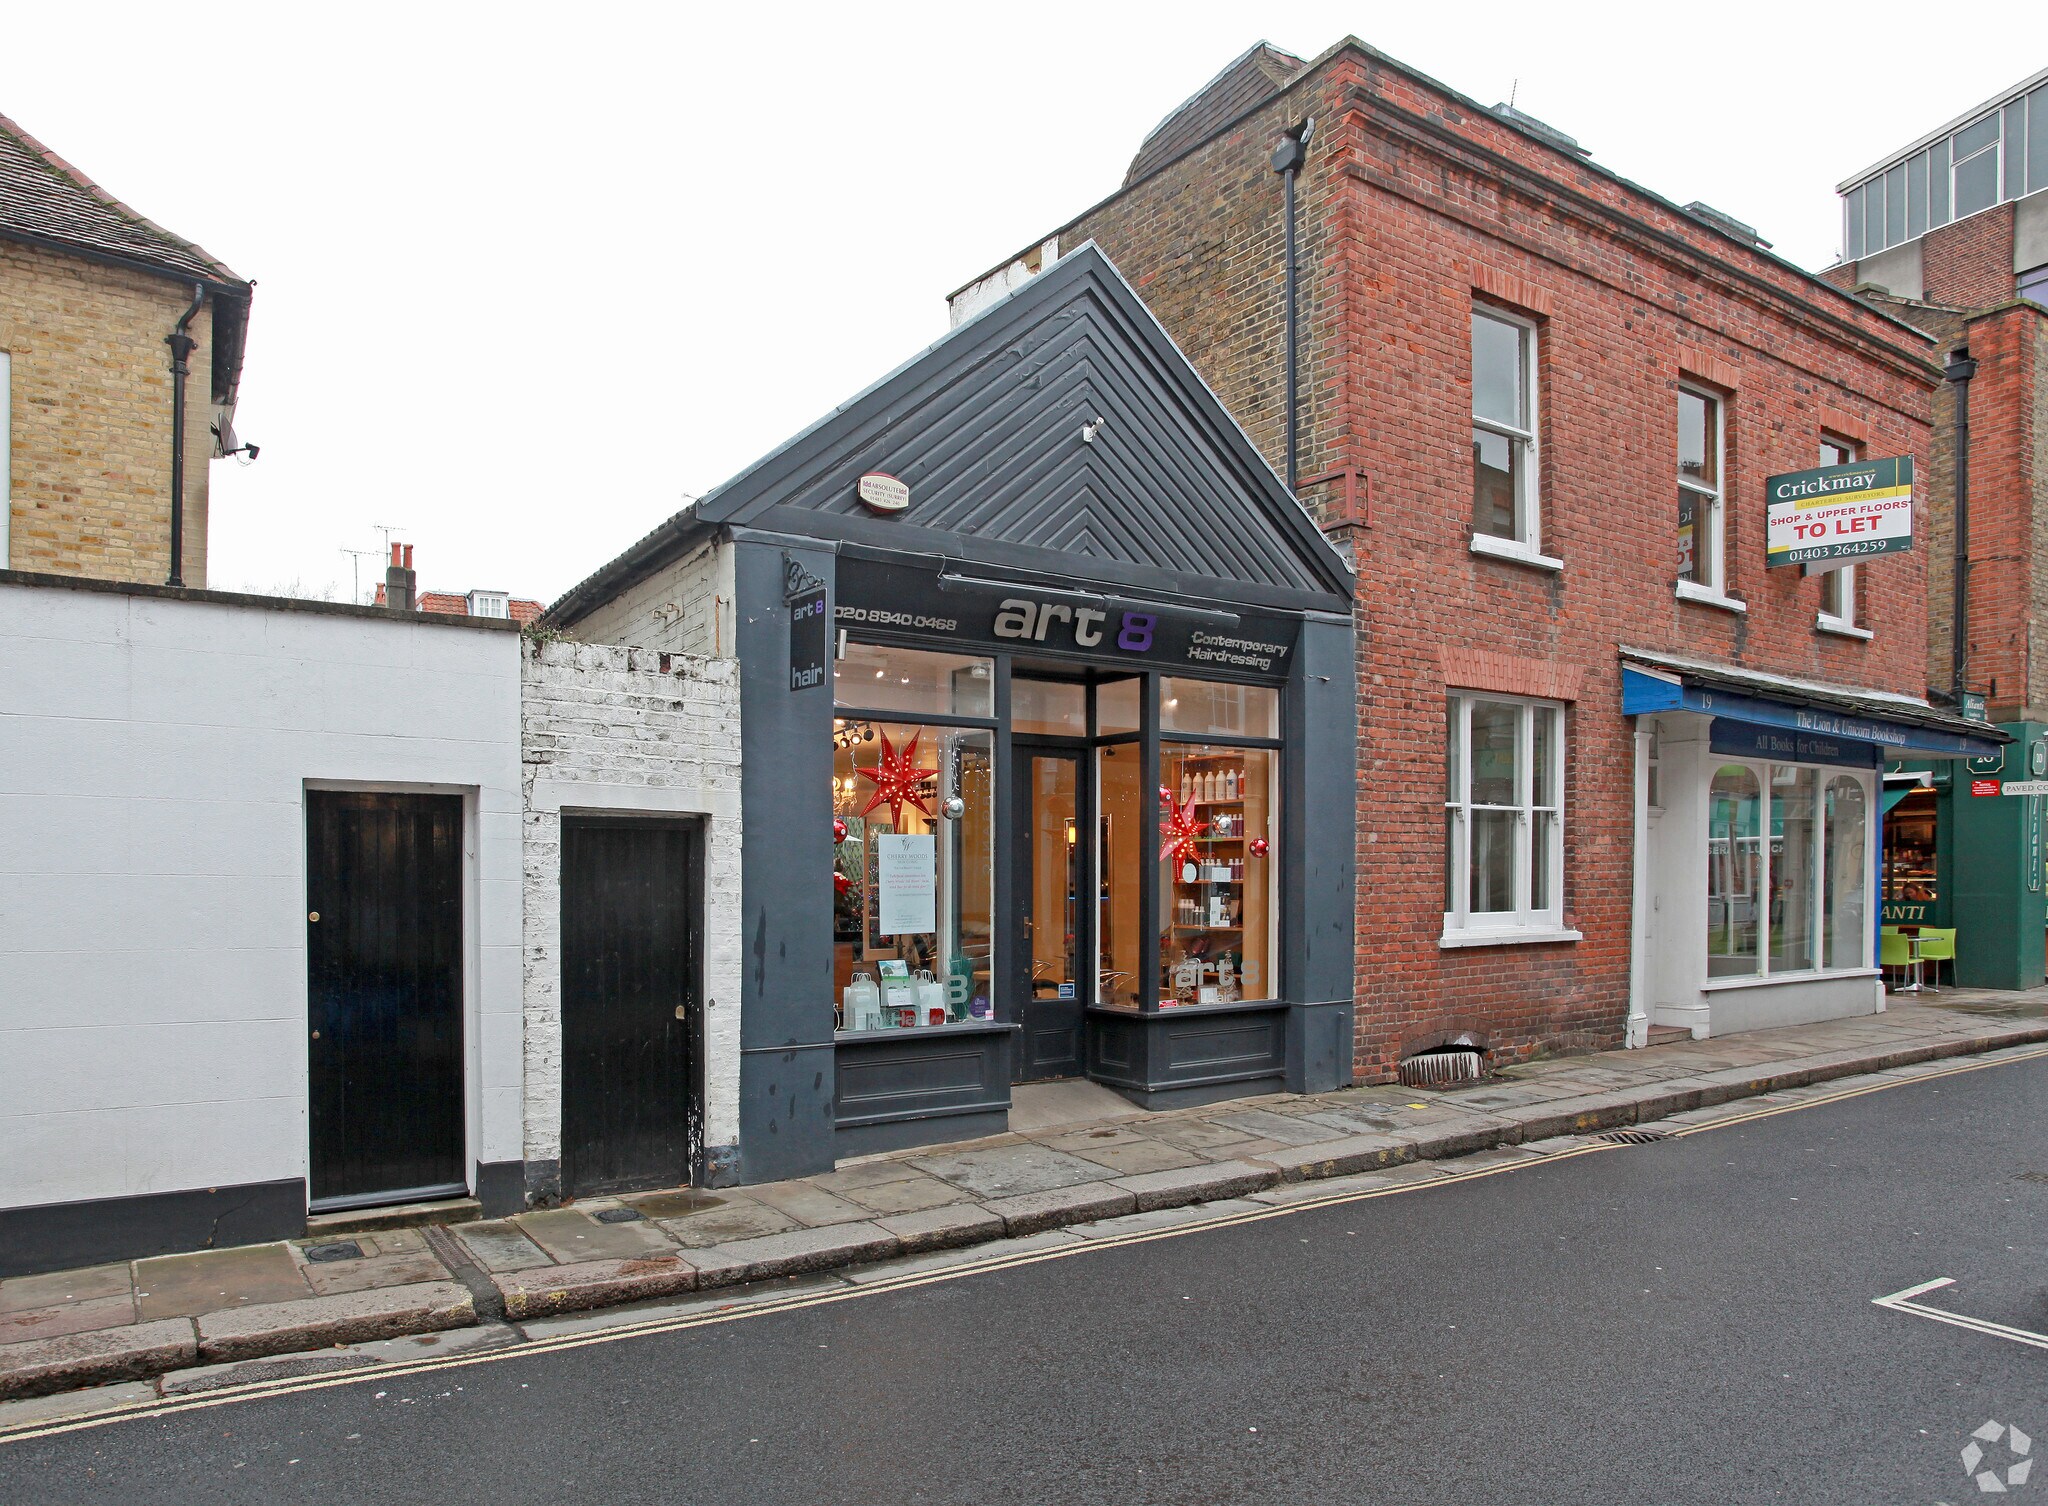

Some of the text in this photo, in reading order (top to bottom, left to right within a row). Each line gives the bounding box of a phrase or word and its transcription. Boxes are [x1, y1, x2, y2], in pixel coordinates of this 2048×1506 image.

[872, 483, 900, 493] ABSOLUTE
[1776, 474, 1876, 498] Crickmay
[1801, 491, 1885, 507] CHARTERED SURVEYORS
[1770, 500, 1908, 526] SHOP & UPPER FLOORS
[1793, 515, 1882, 540] TO LET
[1789, 540, 1887, 561] 01403 264259
[794, 600, 824, 621] art 8
[834, 606, 958, 631] 020 8940 0468
[993, 598, 1157, 652] art 8
[1191, 631, 1288, 657] Contemporary
[1187, 646, 1271, 671] Hairdressing
[792, 662, 823, 688] hair
[1701, 693, 1712, 709] 19
[1796, 712, 1906, 744] The Lion & Unicorn Bookshop
[1756, 735, 1840, 756] All Books for Children
[1959, 738, 1967, 751] 19
